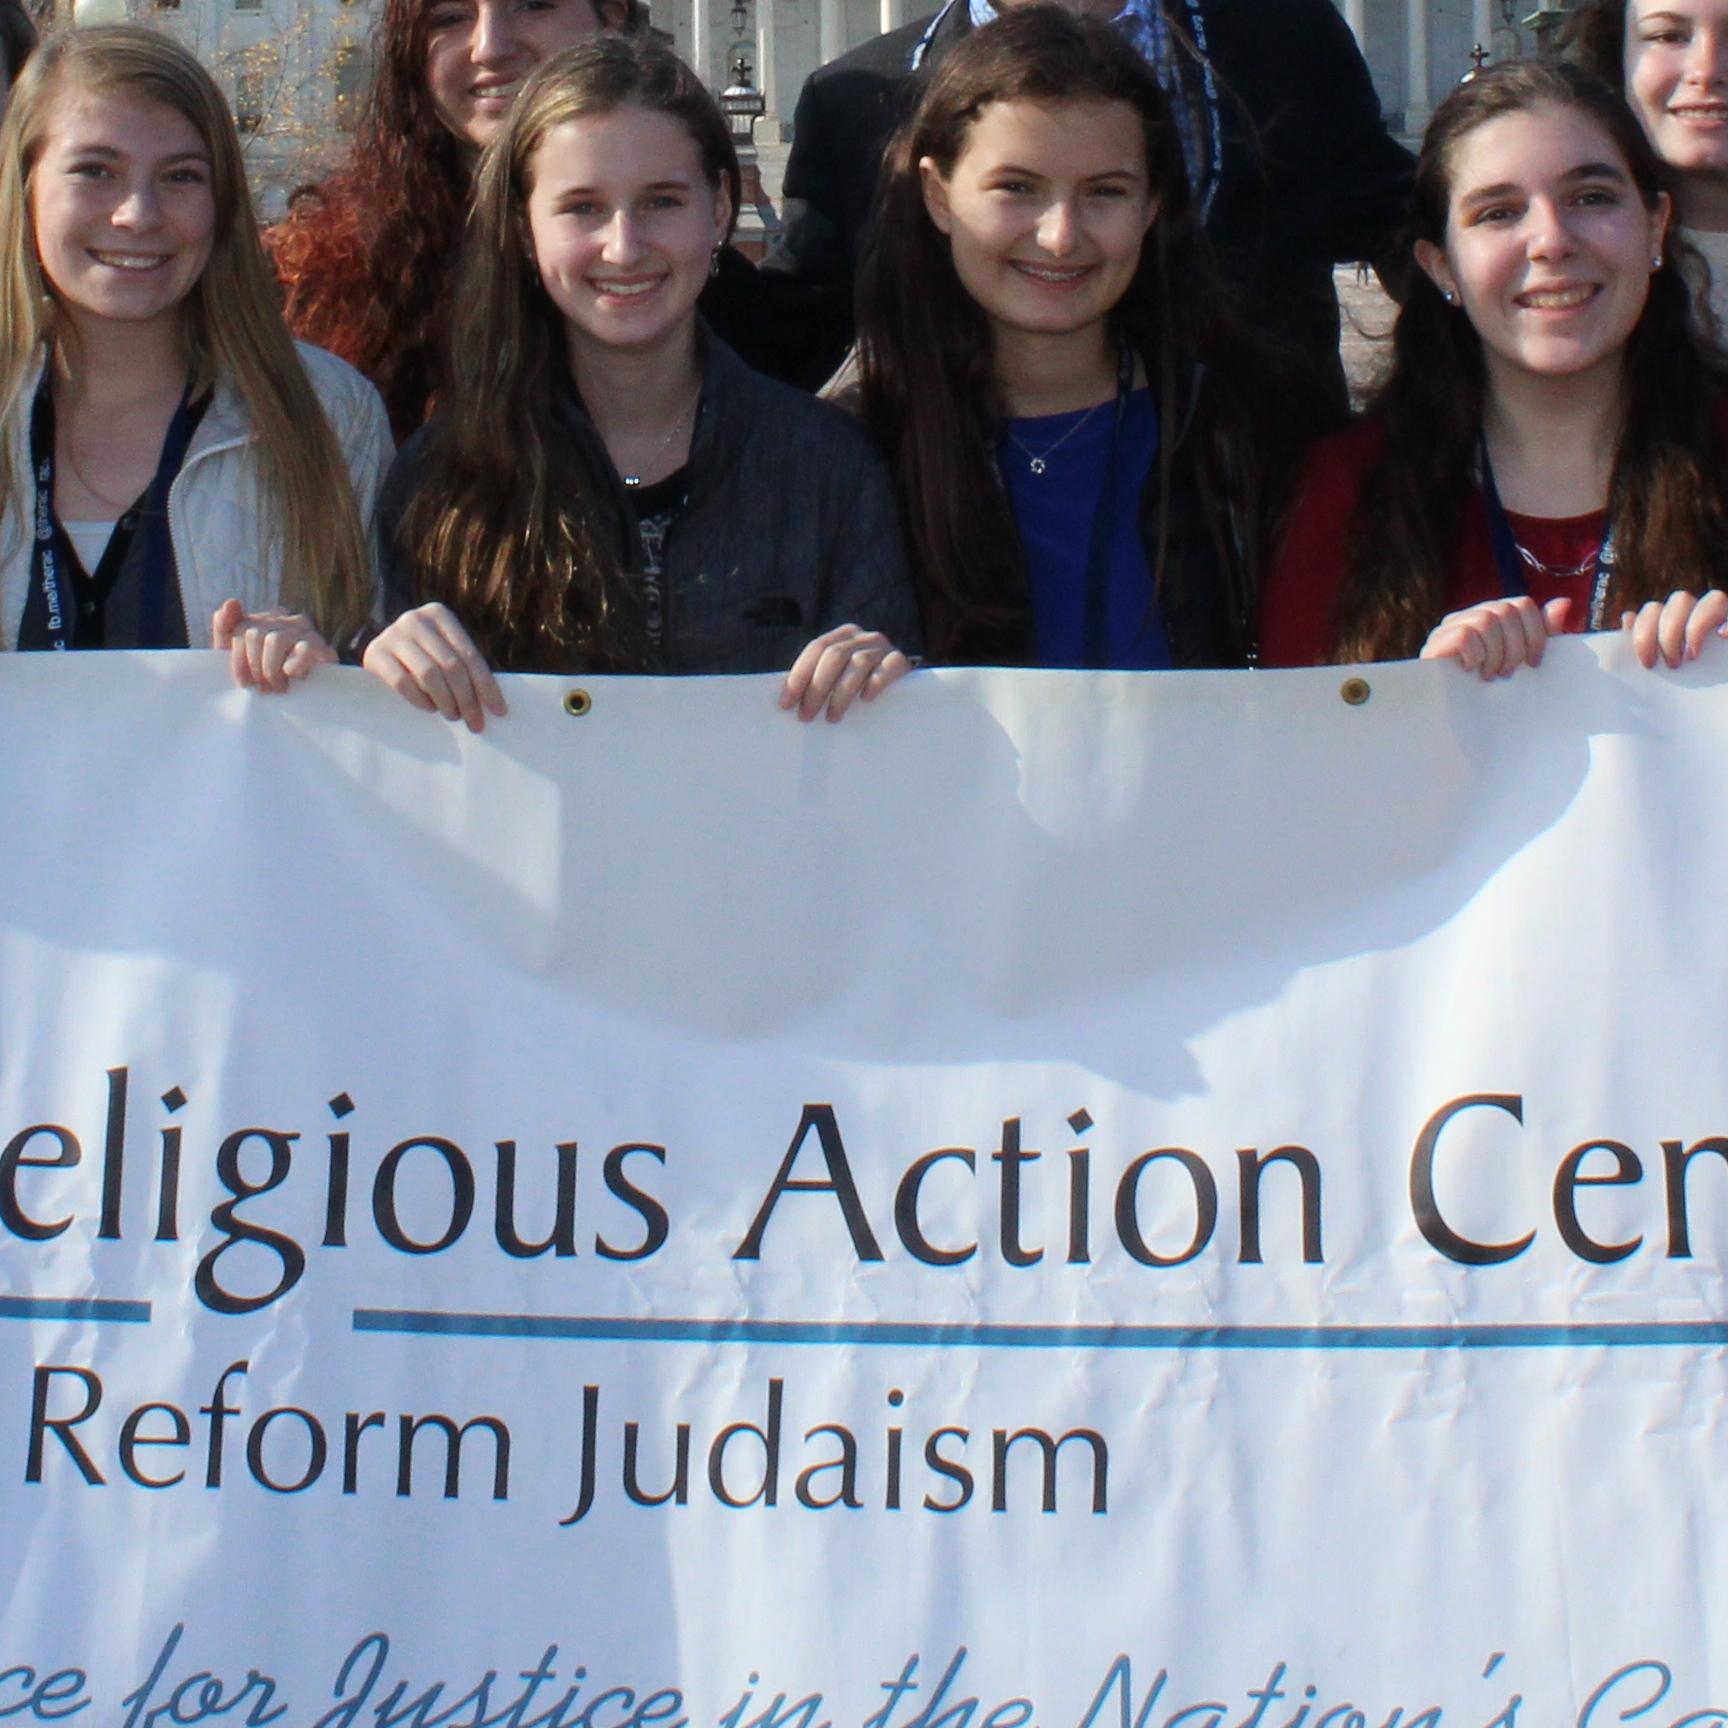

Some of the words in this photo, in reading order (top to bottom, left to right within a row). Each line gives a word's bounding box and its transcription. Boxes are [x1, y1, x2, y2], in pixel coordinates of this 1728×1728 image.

[36, 489, 53, 541] @therac
[41, 549, 62, 630] fb.me/therac
[731, 1105, 1324, 1270] Action
[24, 1361, 510, 1502] Reform
[559, 1380, 1108, 1529] Judaism
[120, 1622, 288, 1728] for
[313, 1634, 689, 1728] Justice
[718, 1670, 832, 1728] in
[862, 1646, 1040, 1728] the
